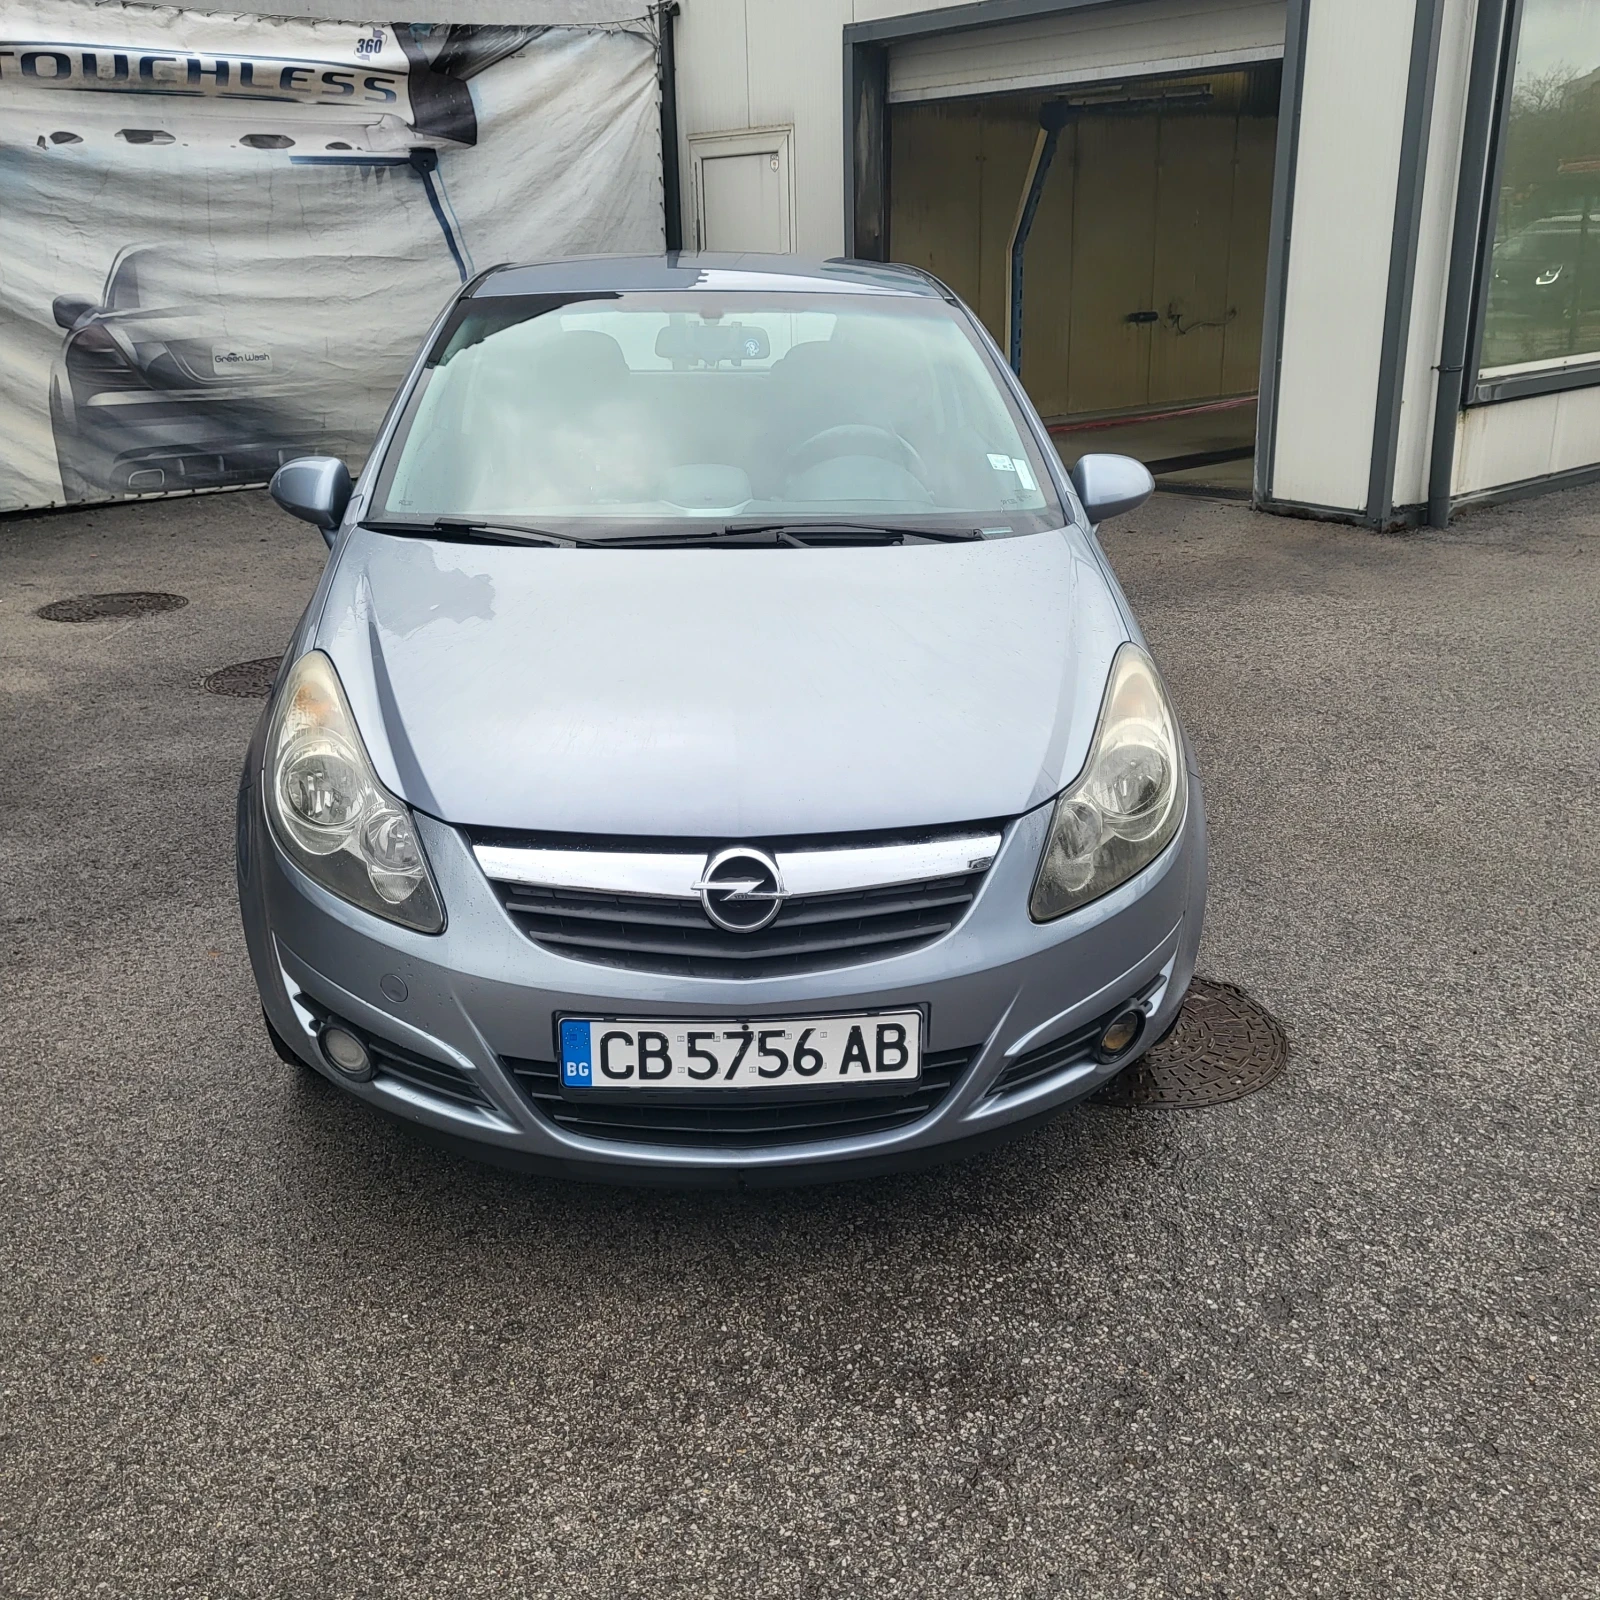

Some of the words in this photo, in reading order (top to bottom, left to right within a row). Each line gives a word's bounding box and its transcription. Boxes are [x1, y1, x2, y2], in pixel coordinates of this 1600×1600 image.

[356, 38, 382, 54] 360
[215, 353, 243, 363] Green
[245, 353, 270, 361] Wash
[600, 1031, 673, 1081] CB
[687, 1028, 824, 1080] 5756
[839, 1023, 909, 1074] AB
[566, 1061, 589, 1077] BG
